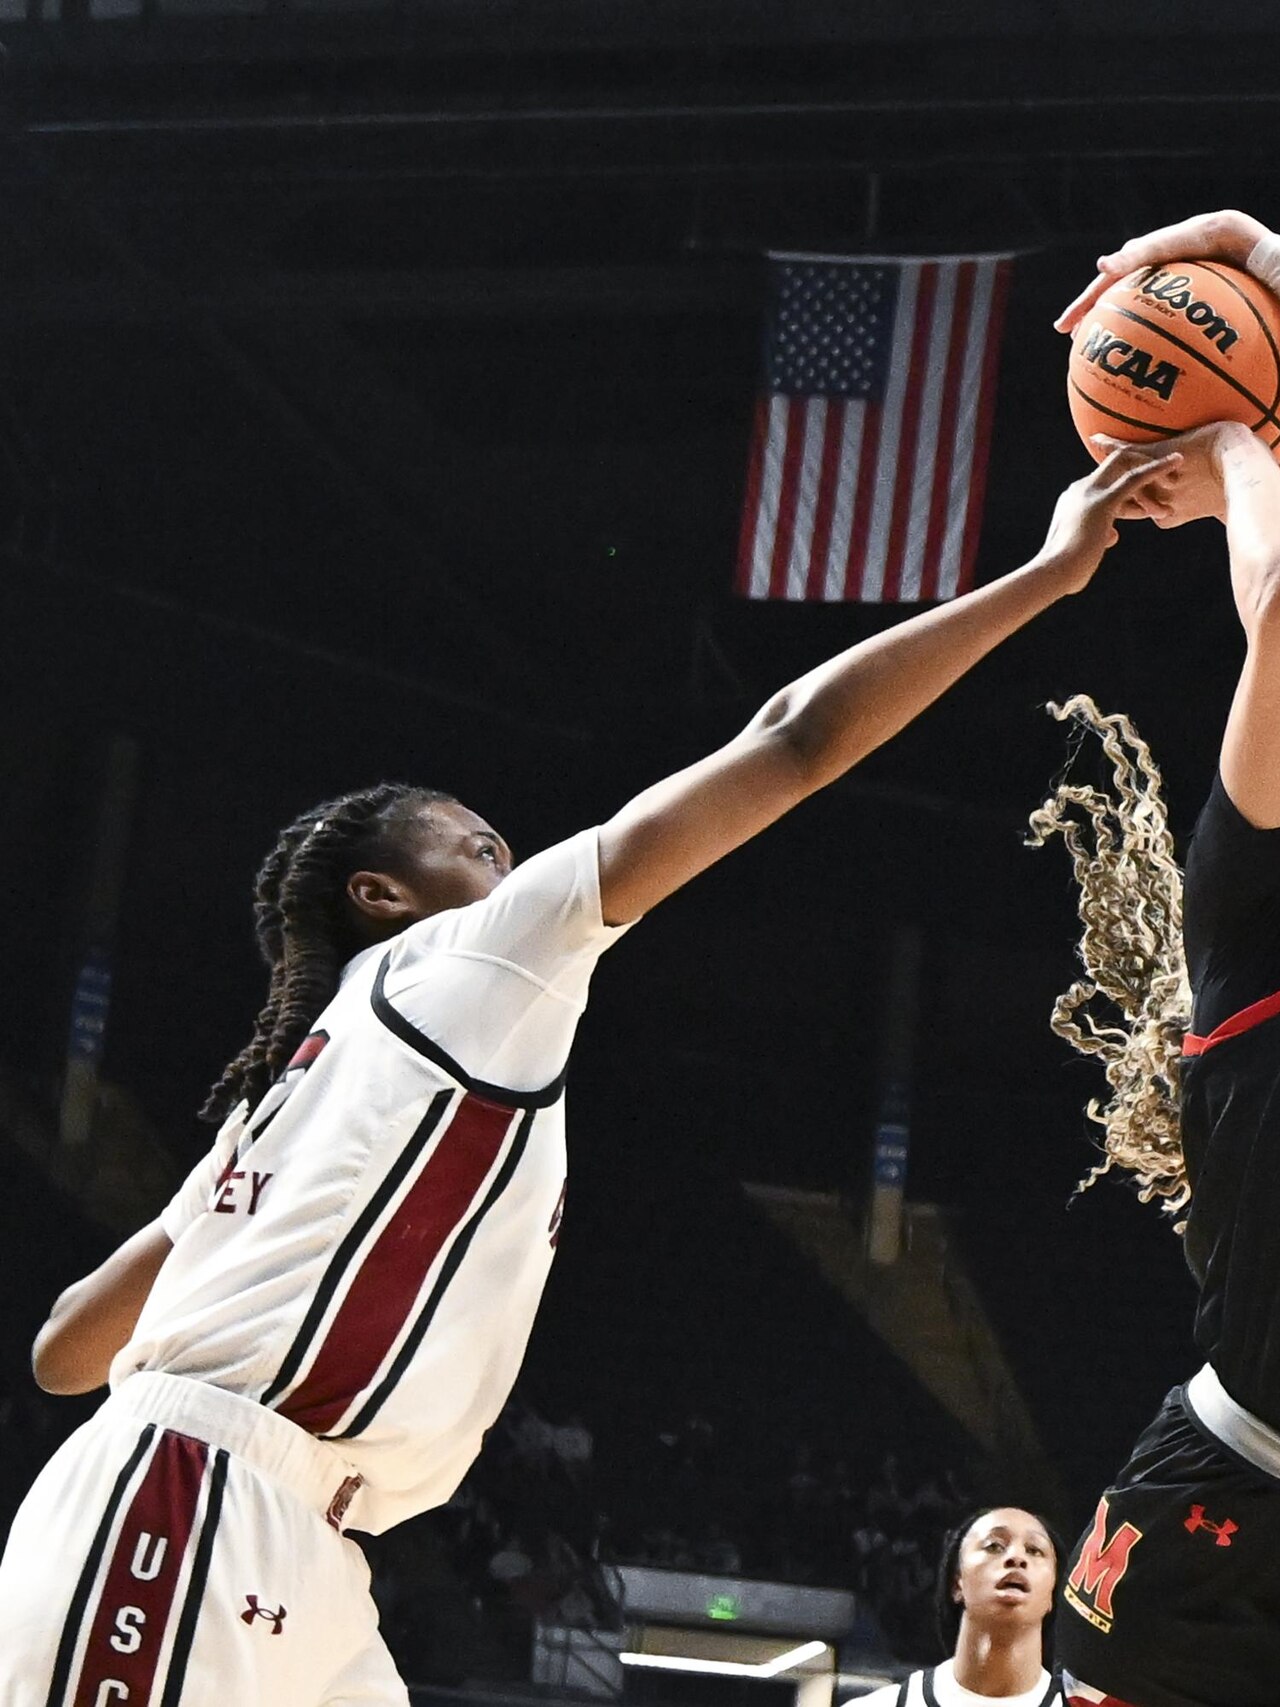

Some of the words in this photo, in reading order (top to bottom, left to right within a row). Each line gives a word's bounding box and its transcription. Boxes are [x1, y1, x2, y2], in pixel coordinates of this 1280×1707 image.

[1079, 323, 1181, 402] NCAA
[213, 1168, 274, 1216] EY
[94, 1531, 168, 1707] USC
